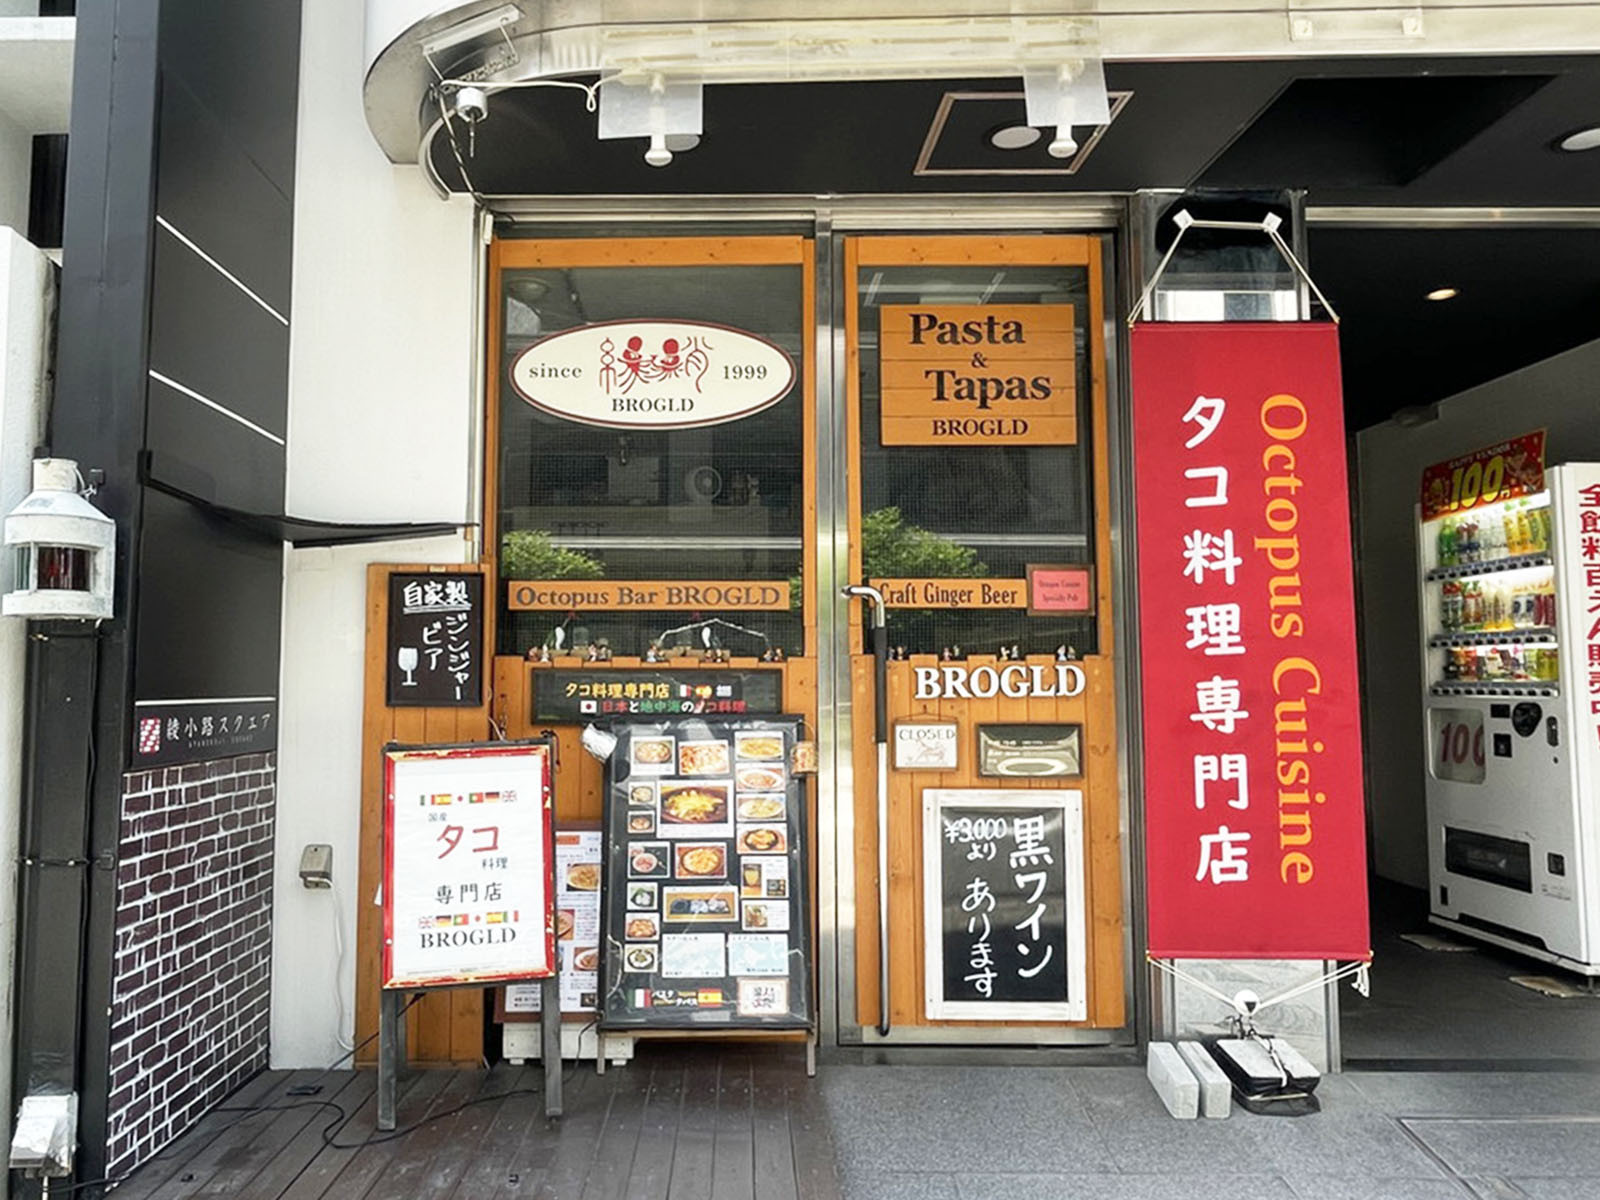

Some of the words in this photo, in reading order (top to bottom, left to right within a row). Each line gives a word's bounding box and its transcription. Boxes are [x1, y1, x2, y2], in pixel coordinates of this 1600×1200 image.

[908, 313, 1026, 345] Pasta
[528, 363, 582, 379] since
[723, 364, 768, 380] 1999
[971, 352, 989, 368] &
[925, 369, 1052, 410] Tapas
[612, 398, 694, 412] BROGLD
[932, 419, 1028, 436] BROGLD
[1254, 393, 1308, 638] Octopus
[403, 581, 470, 606] 自家製
[516, 587, 609, 608] Octopus
[617, 587, 658, 605] Bar
[666, 586, 780, 605] BROGLD
[881, 582, 917, 605] Craft
[923, 583, 973, 607] Ginger
[981, 583, 1018, 605] Beer
[423, 621, 443, 671] ビア
[1181, 395, 1251, 884] タコ料理専門店
[445, 612, 471, 700] ジンジャー
[565, 682, 670, 699] タコ料理専門店
[914, 665, 1087, 699] BROGLD
[166, 713, 271, 741] 綾小路スクエア
[899, 727, 956, 741] CLOSED
[1272, 657, 1326, 884] Cuisine
[436, 825, 499, 859] タコ
[966, 842, 996, 861] より
[435, 882, 503, 905] 専門店
[1009, 815, 1054, 978] 黒ワイン
[420, 928, 517, 949] BROGLD
[962, 877, 998, 998] あります
